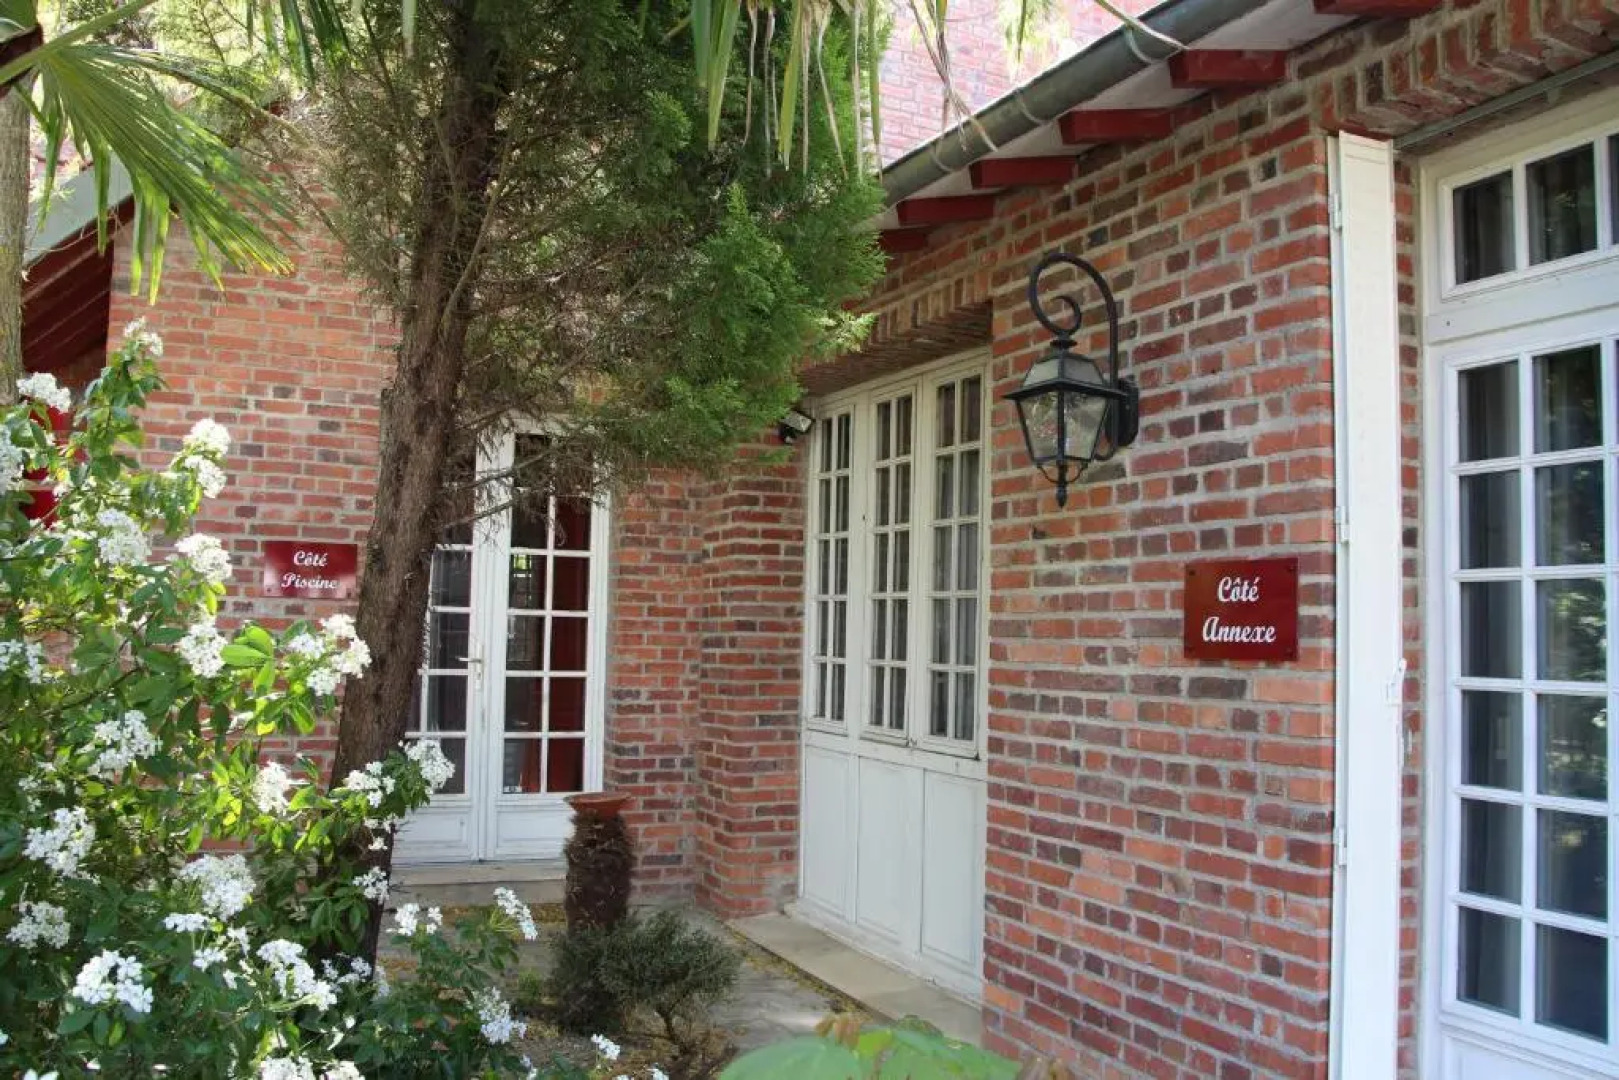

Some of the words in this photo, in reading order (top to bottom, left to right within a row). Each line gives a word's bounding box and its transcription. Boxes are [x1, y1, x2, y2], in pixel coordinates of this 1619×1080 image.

[293, 550, 328, 567] Côté
[281, 572, 338, 589] Piscine
[1218, 576, 1260, 602] Côté
[1202, 616, 1276, 643] Annexe
